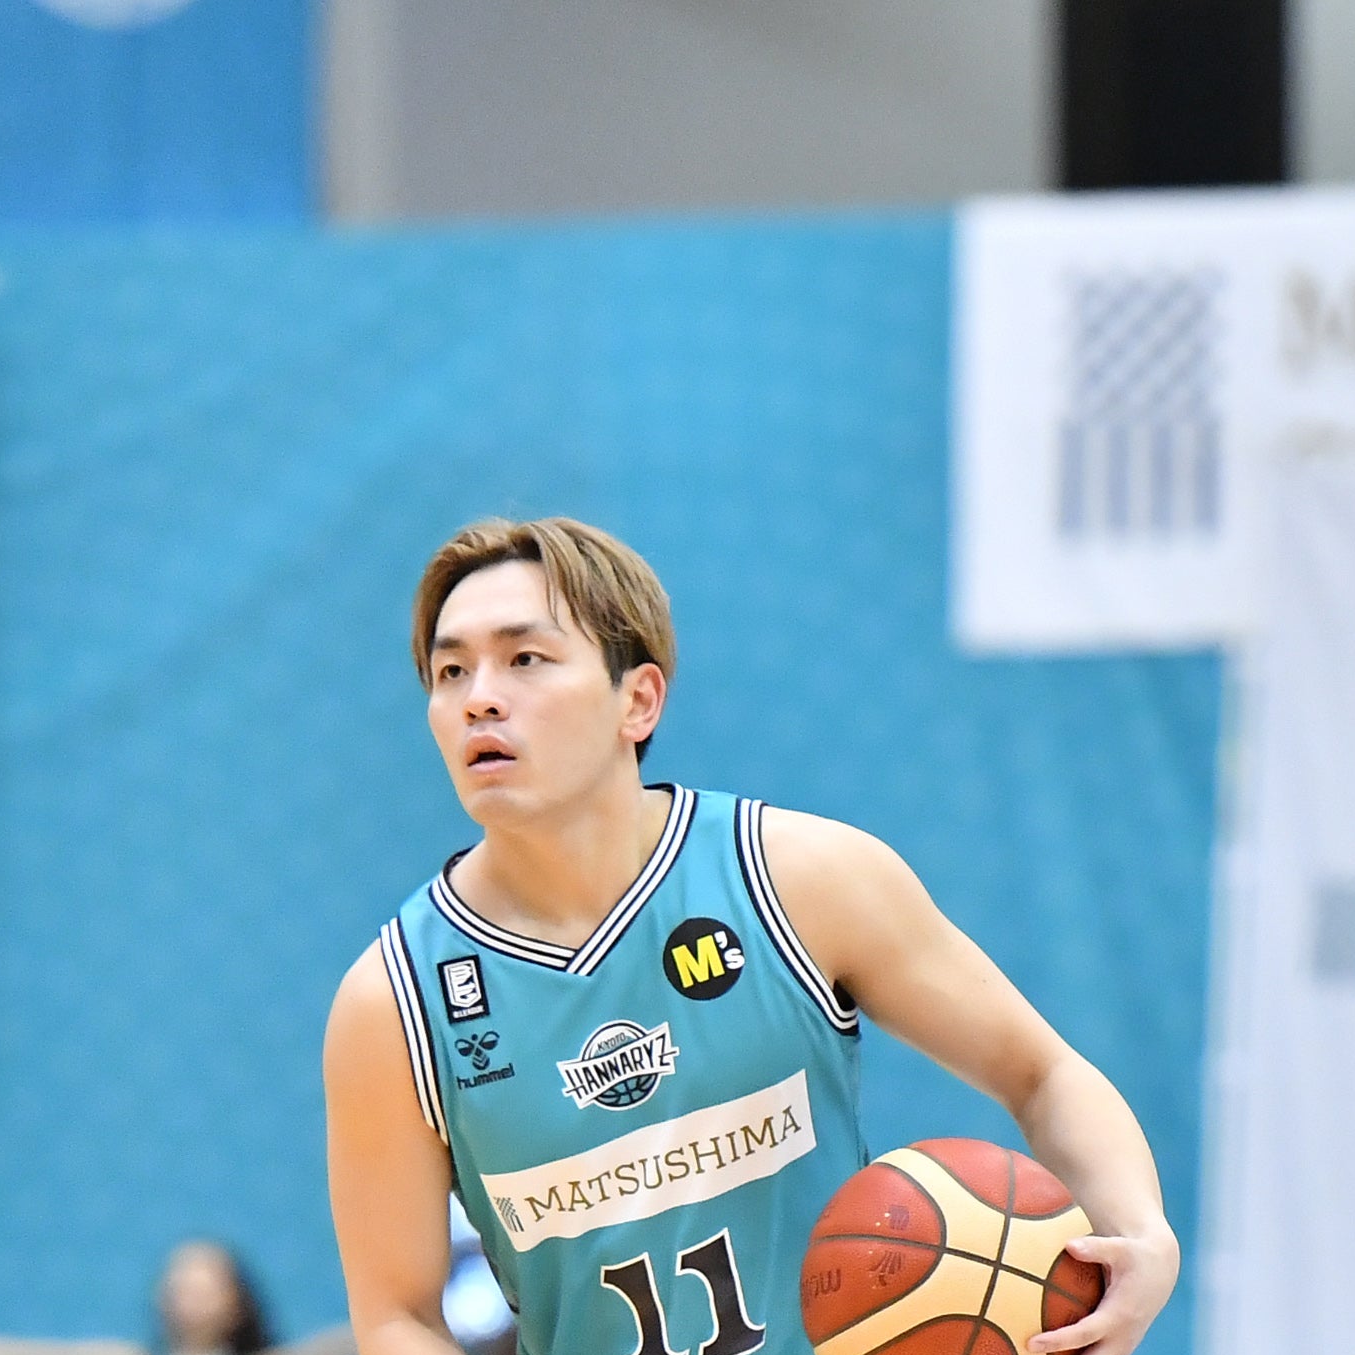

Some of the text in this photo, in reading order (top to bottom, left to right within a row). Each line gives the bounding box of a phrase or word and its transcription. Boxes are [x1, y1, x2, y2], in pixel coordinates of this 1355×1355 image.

[671, 930, 745, 988] M's
[565, 1033, 678, 1100] HANNARYZ
[596, 1031, 627, 1052] KYOTO
[456, 1063, 515, 1090] hummel
[524, 1105, 802, 1222] MATSUSHIMA
